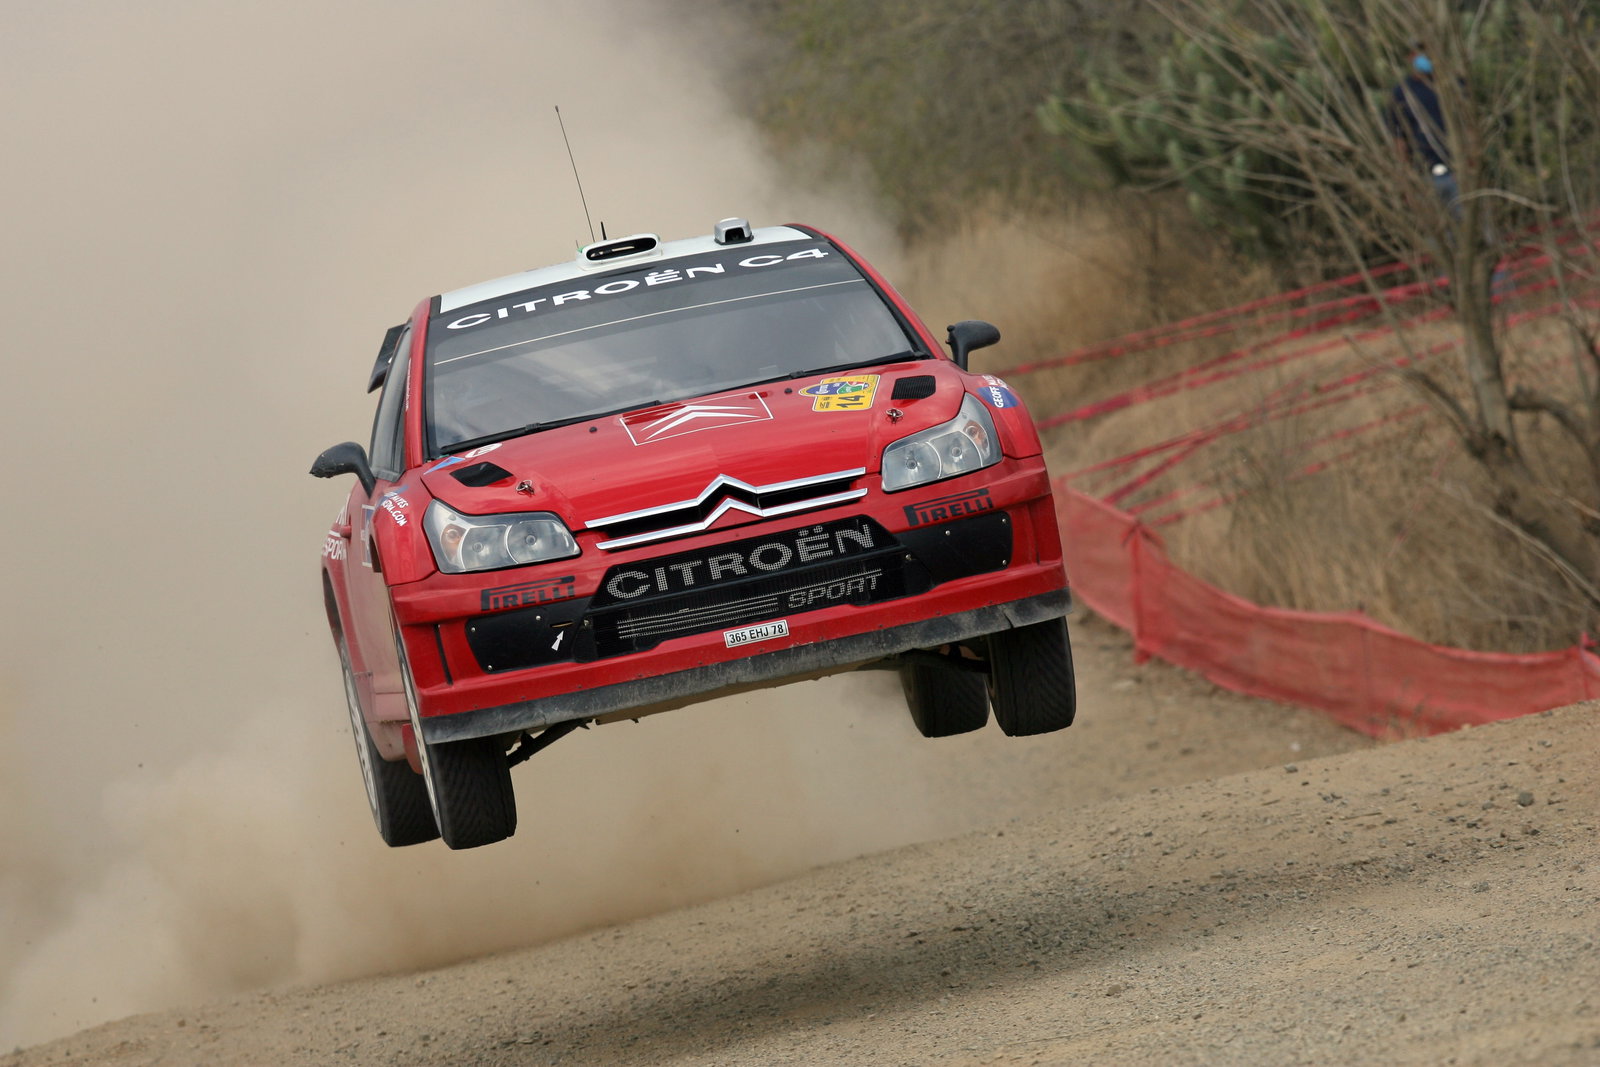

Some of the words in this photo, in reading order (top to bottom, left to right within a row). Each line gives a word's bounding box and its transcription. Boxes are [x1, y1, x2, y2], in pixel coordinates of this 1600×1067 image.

[446, 263, 726, 330] CITROËN
[738, 248, 829, 268] C4
[836, 395, 865, 409] 14
[902, 487, 994, 527] PIRELLI
[606, 525, 875, 599] CITROËN
[481, 575, 576, 611] PIRELLI
[788, 569, 883, 608] SPORT
[729, 631, 747, 643] 365
[749, 626, 769, 639] EHJ
[771, 624, 784, 635] 78
